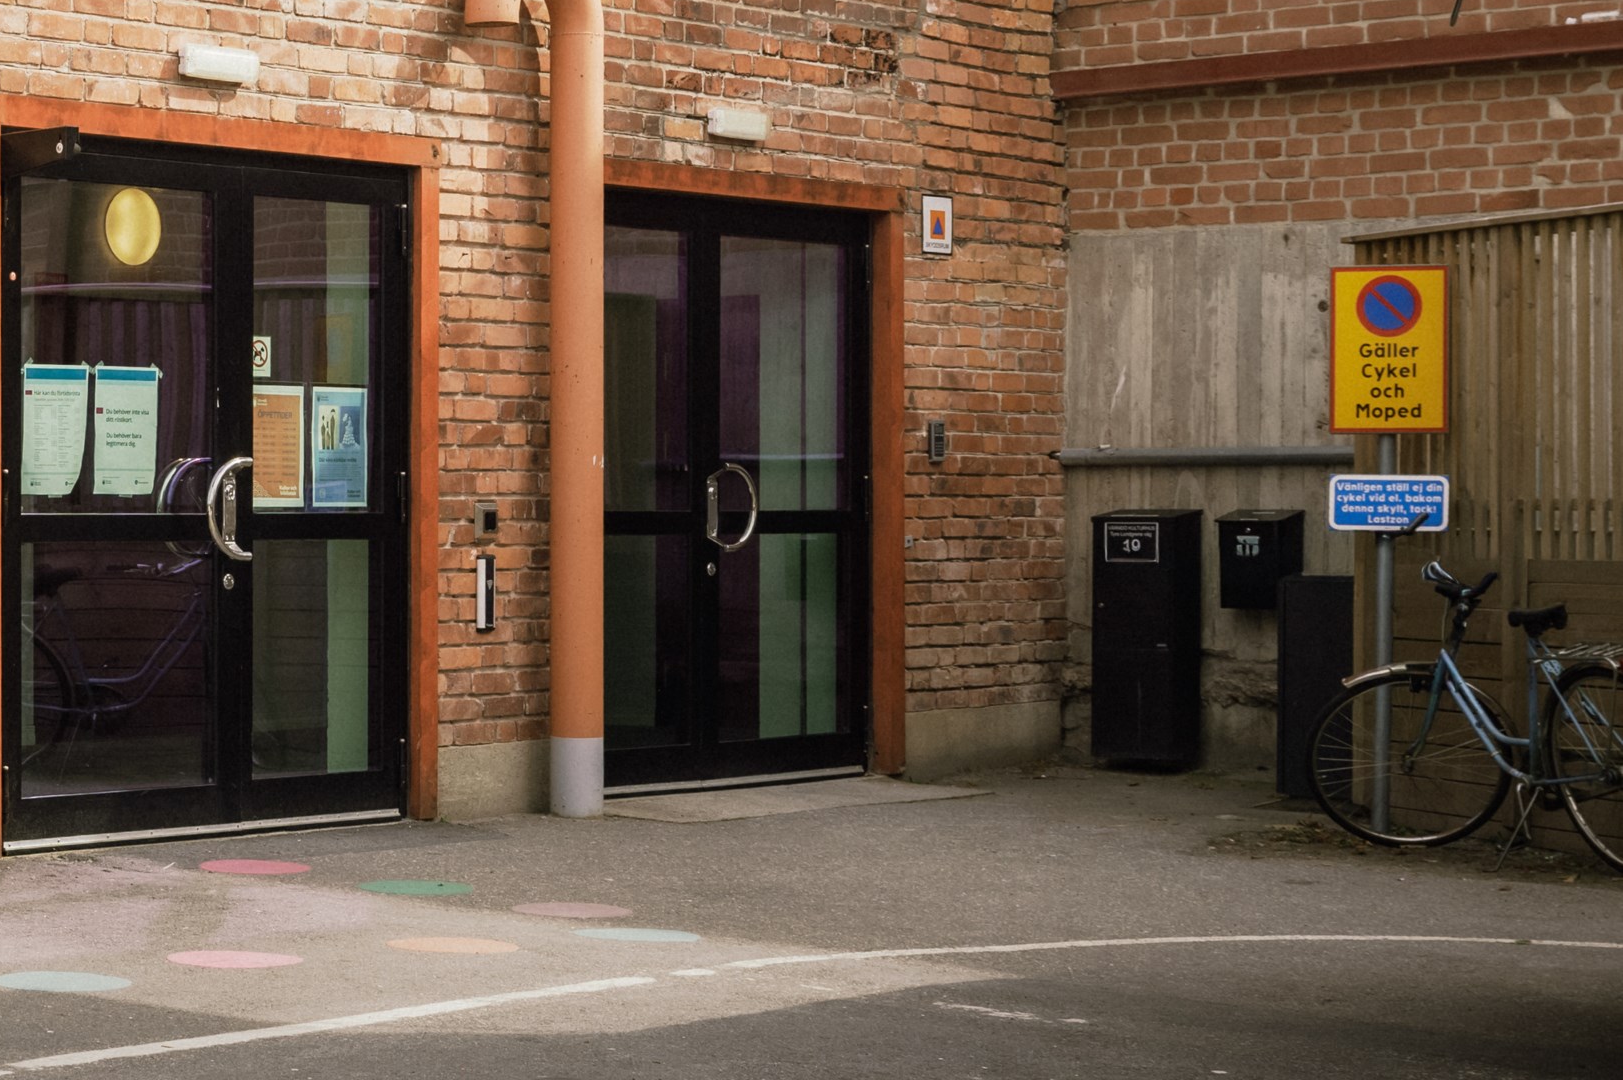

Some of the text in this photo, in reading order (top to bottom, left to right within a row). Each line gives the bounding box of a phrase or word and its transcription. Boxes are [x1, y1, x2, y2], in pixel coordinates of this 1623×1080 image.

[1359, 343, 1419, 358] Gäller
[1361, 364, 1417, 381] Cykel
[1370, 384, 1405, 398] och
[1355, 403, 1422, 421] Moped
[1337, 482, 1443, 493] Vänligen ställ ej din
[1336, 493, 1366, 503] cykel
[1369, 493, 1386, 502] vid
[1405, 494, 1442, 503] bakom
[1341, 504, 1374, 513] denna
[1377, 504, 1407, 514] skylt,
[1367, 515, 1410, 523] Lastzon
